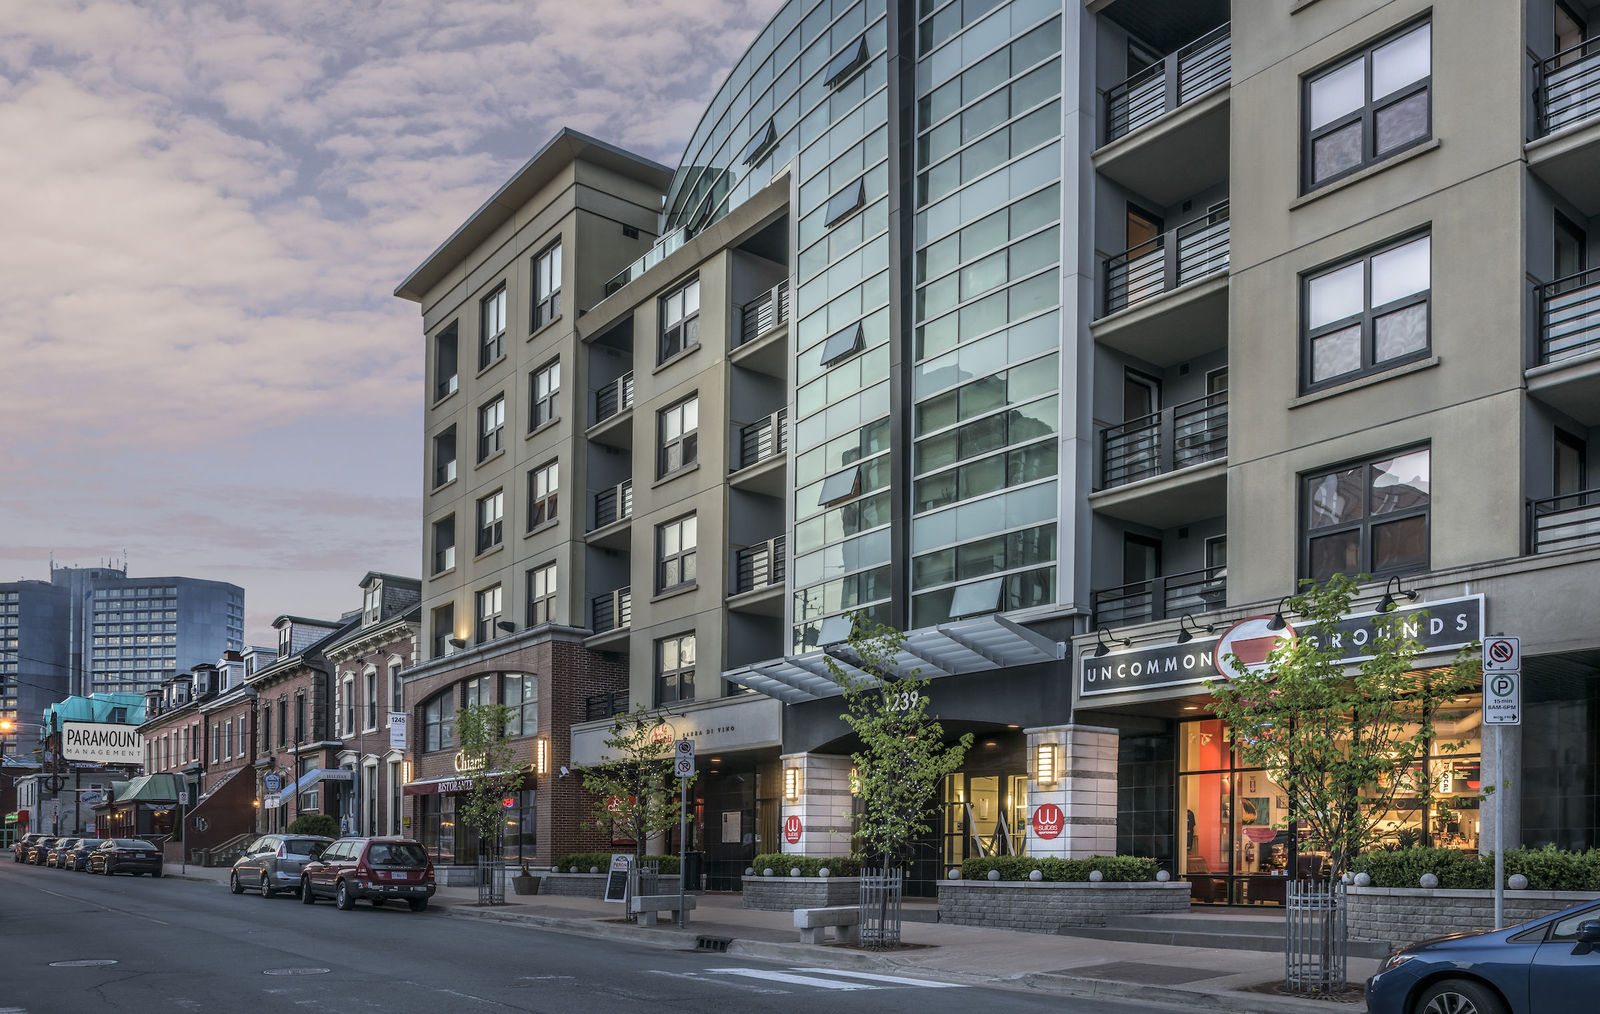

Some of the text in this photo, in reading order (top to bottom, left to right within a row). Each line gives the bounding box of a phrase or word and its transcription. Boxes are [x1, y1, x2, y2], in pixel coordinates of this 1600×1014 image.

[1087, 613, 1468, 683] UNCOMMON GROUNDS
[1498, 680, 1508, 694] P
[886, 691, 919, 712] 1239
[717, 725, 735, 733] VINO
[67, 729, 141, 748] PARAMOUNT
[66, 748, 142, 757] MANAGEMENT
[1038, 808, 1058, 825] W
[787, 819, 799, 832] W
